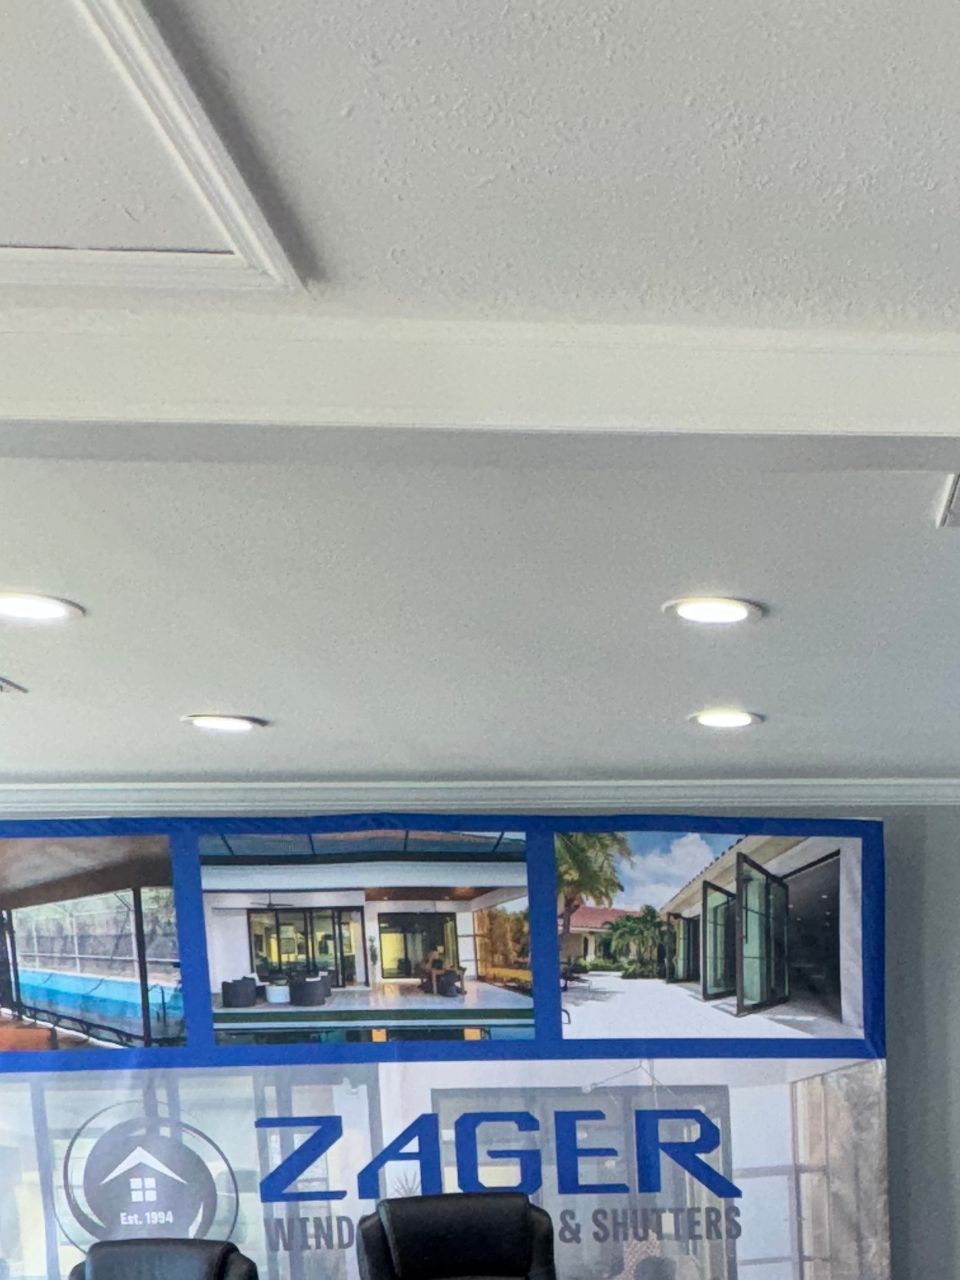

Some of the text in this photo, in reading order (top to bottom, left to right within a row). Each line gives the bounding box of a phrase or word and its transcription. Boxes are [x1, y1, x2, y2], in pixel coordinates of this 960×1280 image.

[254, 1109, 743, 1203] ZAGER
[120, 1212, 143, 1225] Est.
[263, 1206, 742, 1251] WIND & SHUTTERS
